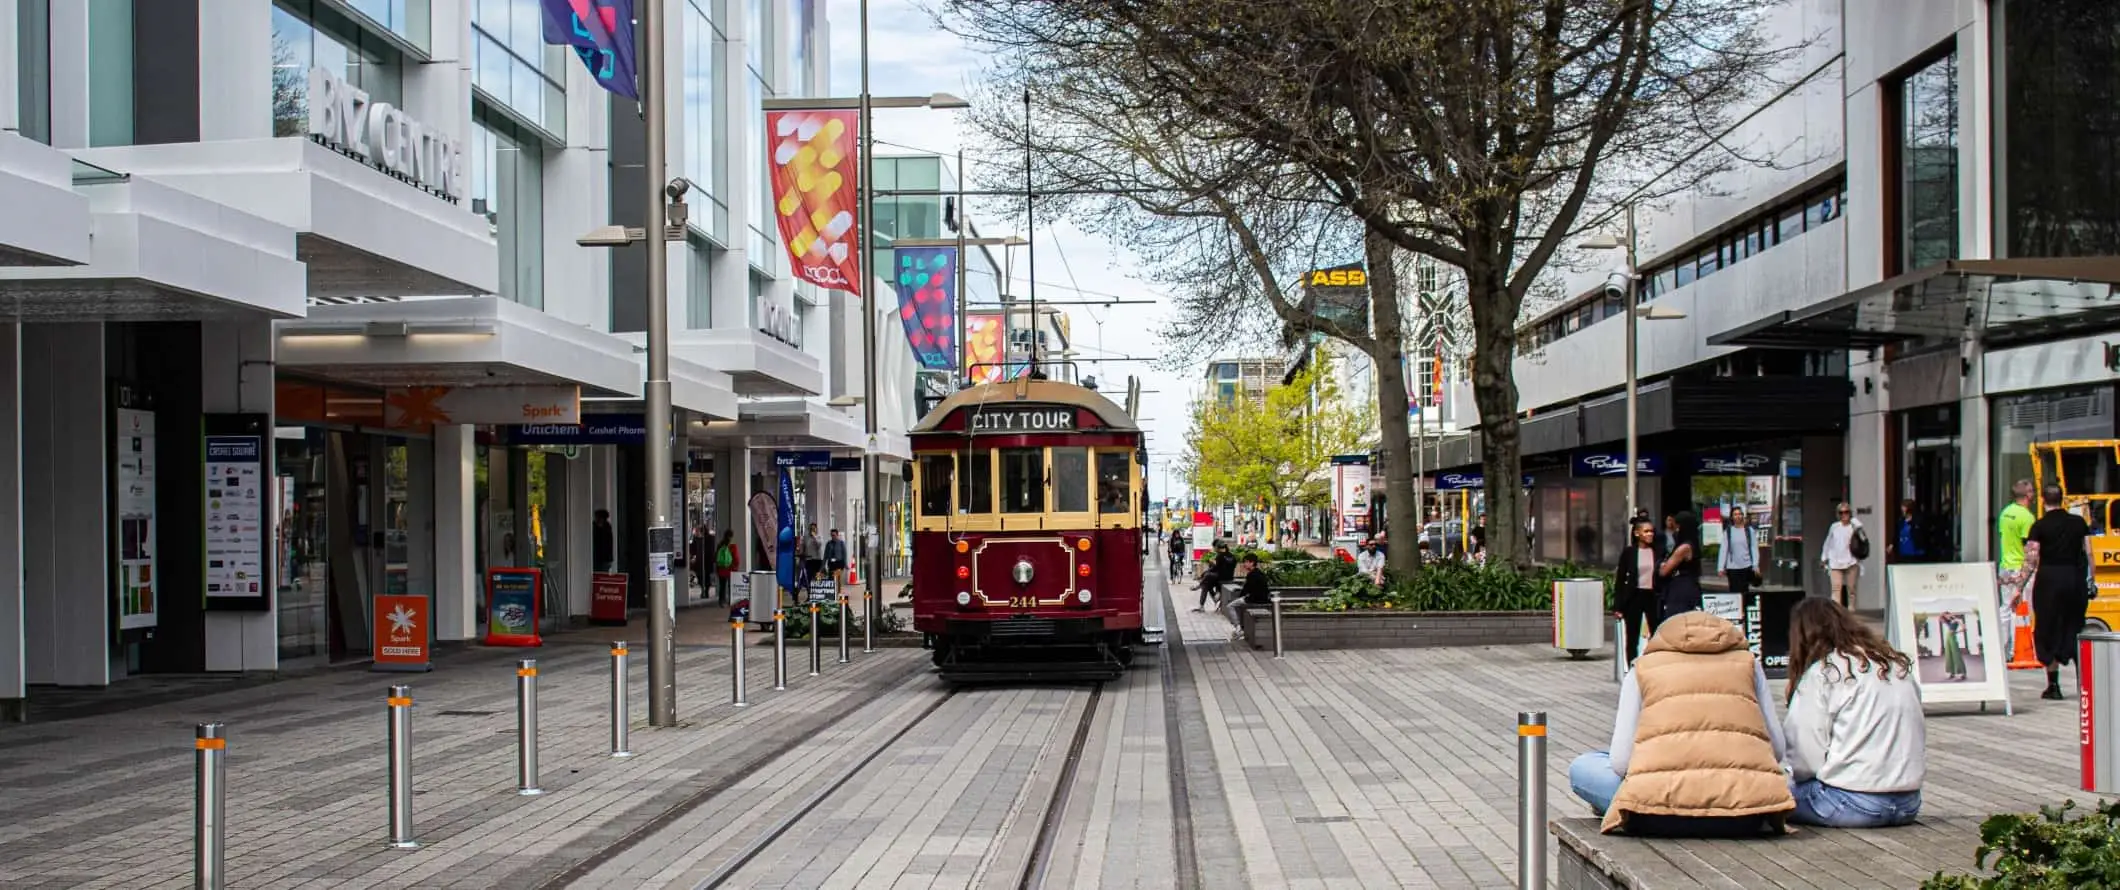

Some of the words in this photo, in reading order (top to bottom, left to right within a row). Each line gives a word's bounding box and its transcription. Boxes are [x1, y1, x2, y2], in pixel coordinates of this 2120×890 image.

[309, 67, 369, 157] BNZ
[369, 102, 463, 200] CENTRE
[1311, 270, 1365, 286] ASB
[522, 404, 563, 418] Spark
[974, 412, 1014, 429] CITY
[1019, 411, 1072, 429] TOUR
[522, 424, 580, 435] Unichem
[1010, 596, 1037, 608] 244
[2080, 684, 2091, 745] Litter
